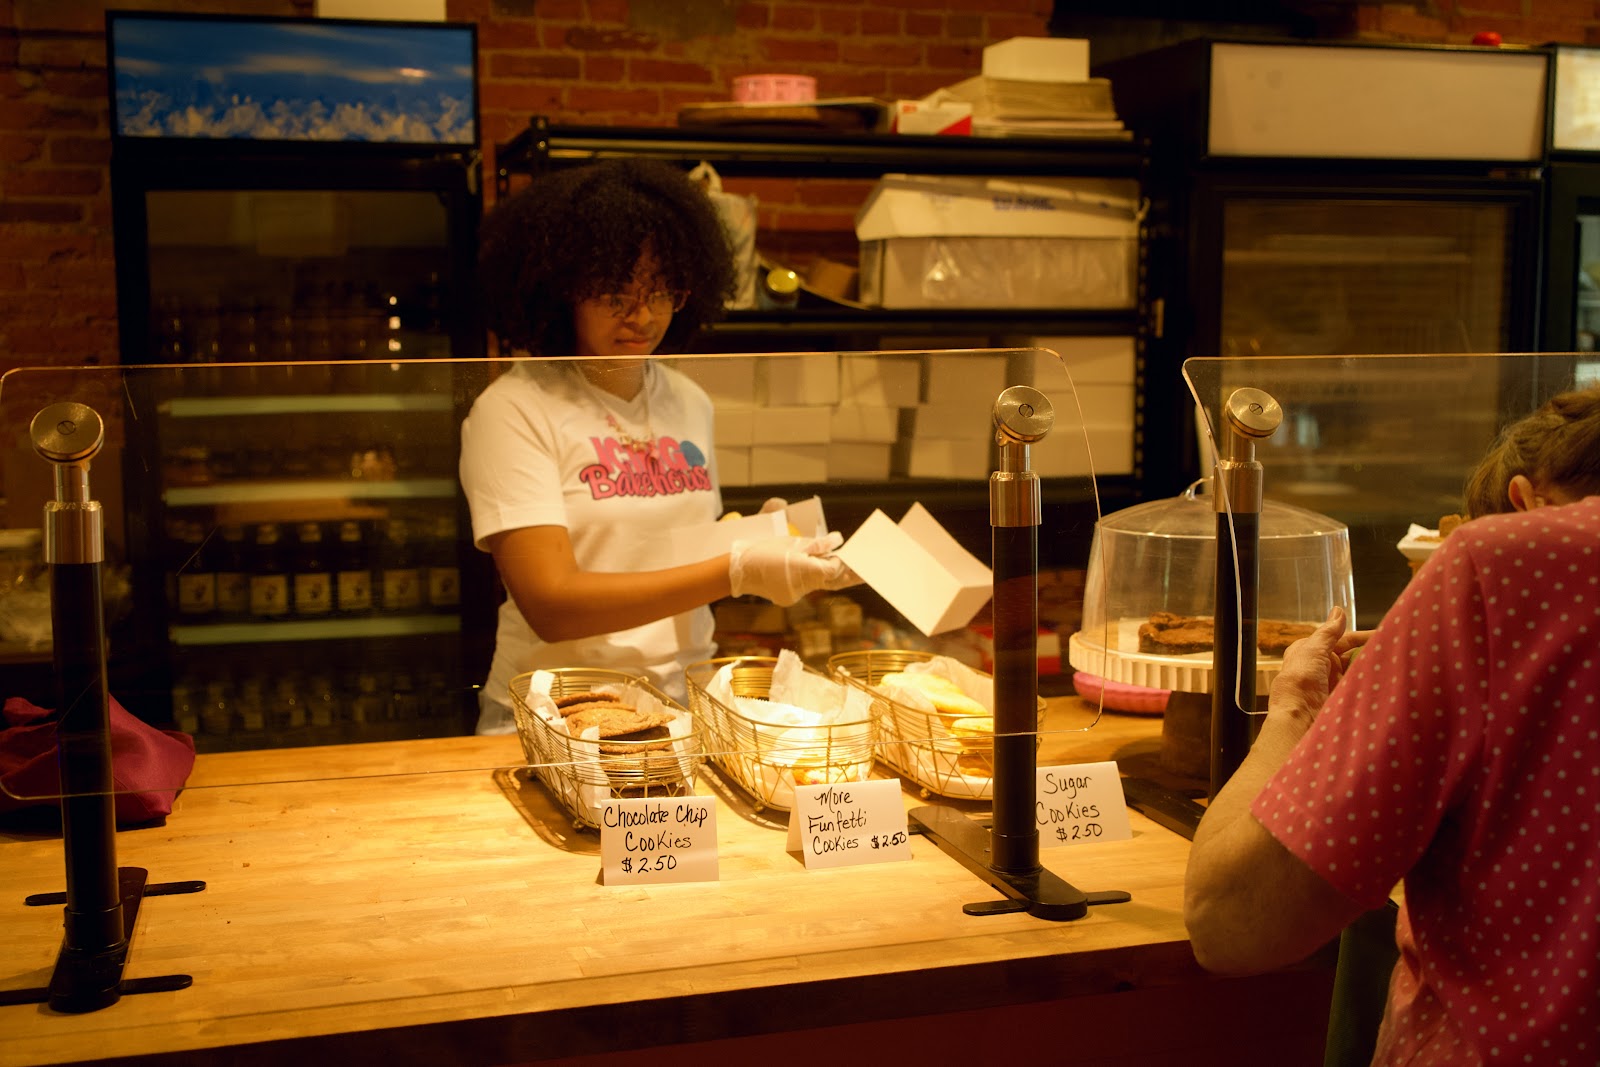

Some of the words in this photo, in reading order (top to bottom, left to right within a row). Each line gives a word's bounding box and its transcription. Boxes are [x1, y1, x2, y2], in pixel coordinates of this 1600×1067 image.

[1043, 773, 1092, 799] Sugar
[814, 787, 853, 813] More
[604, 803, 669, 828] Chocolate
[675, 803, 708, 828] Chip
[808, 808, 867, 834] Funfetti
[871, 831, 907, 849] $2.50
